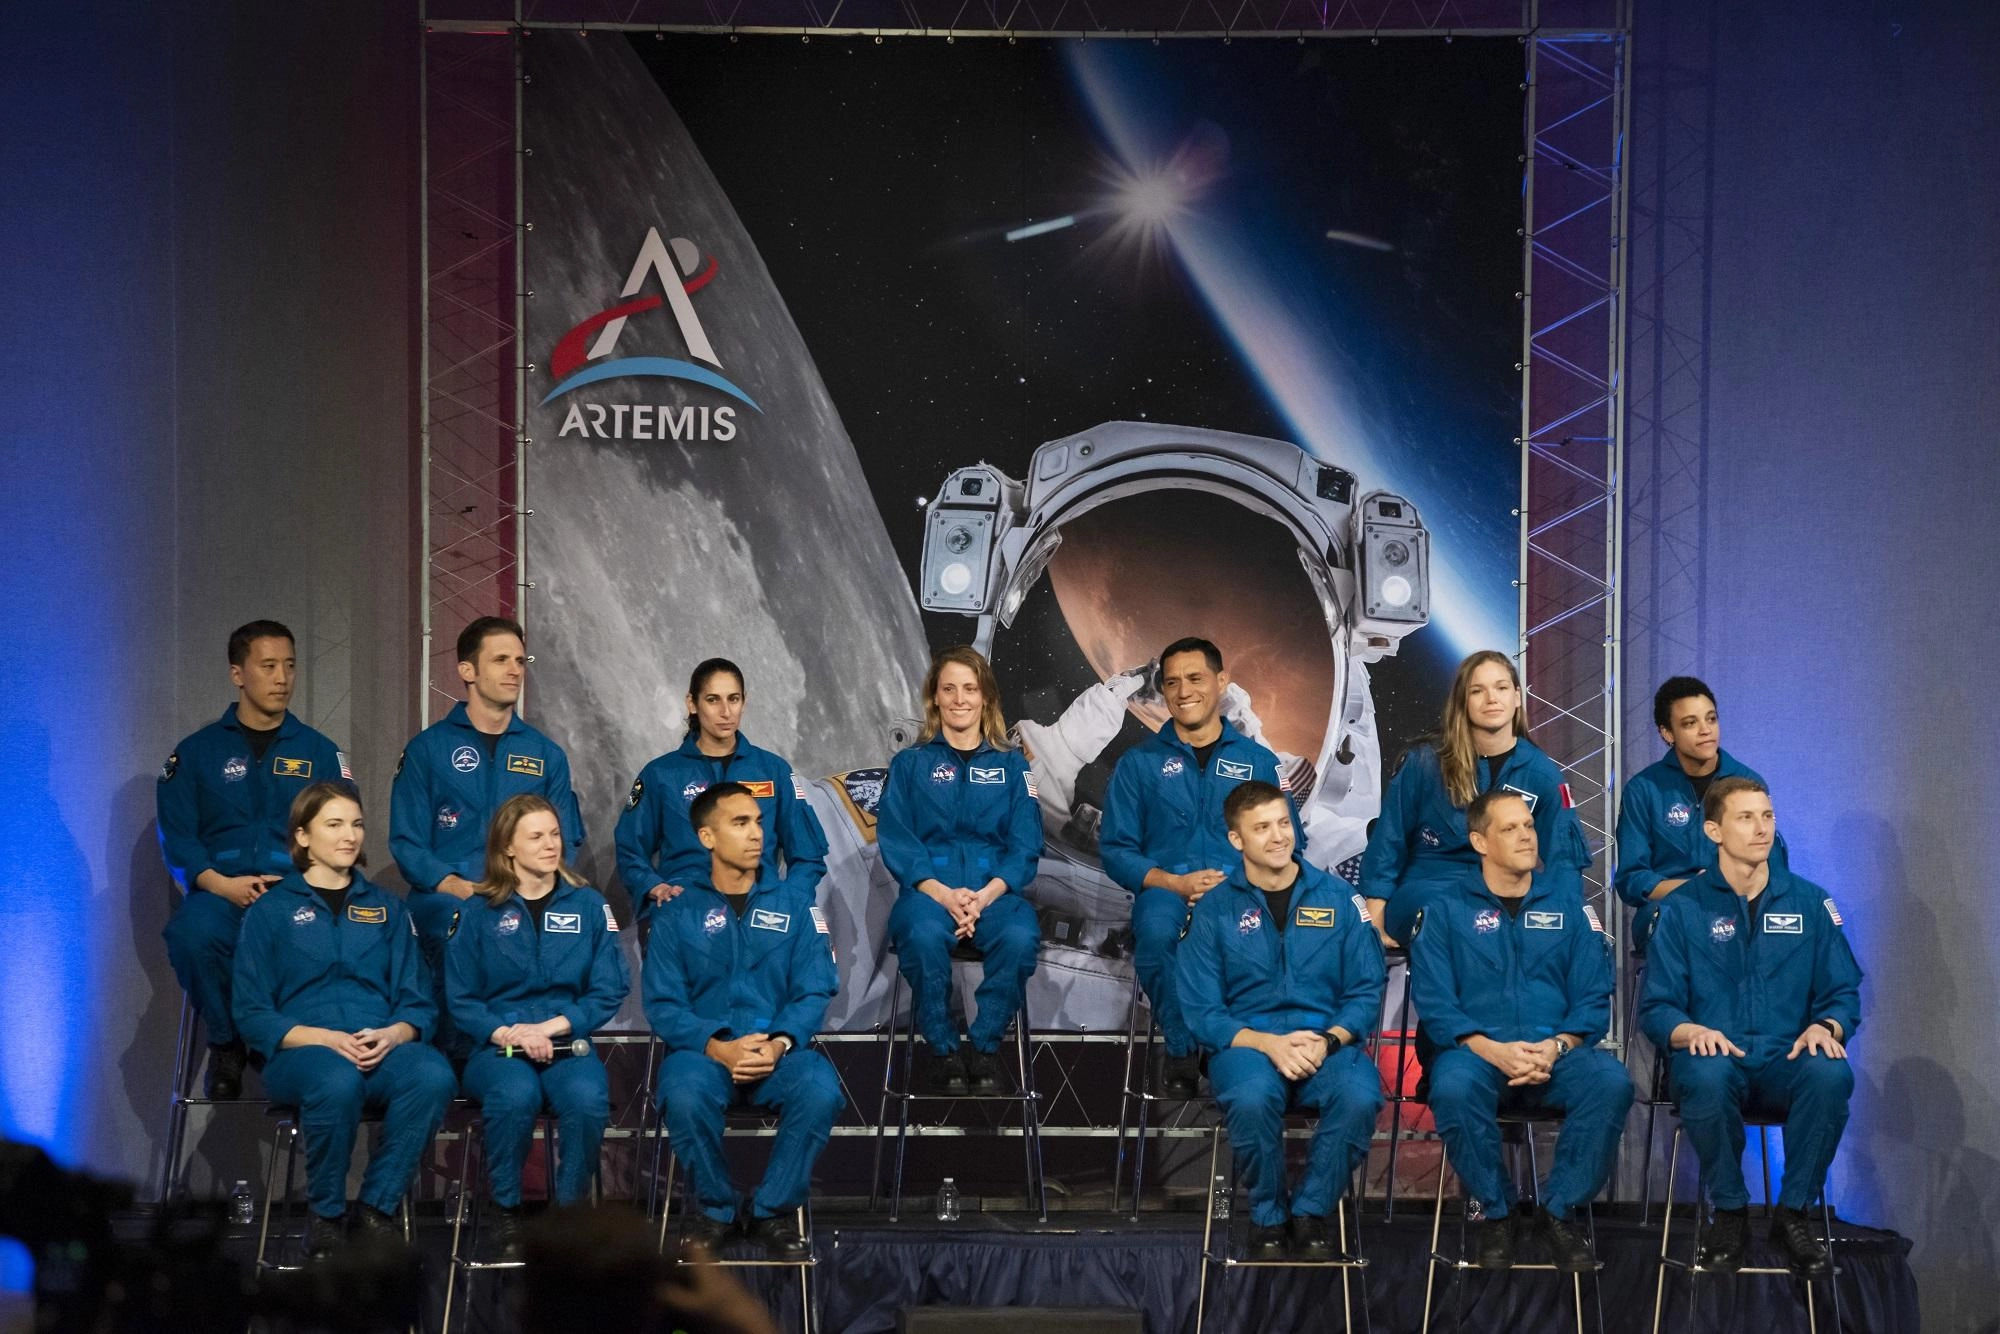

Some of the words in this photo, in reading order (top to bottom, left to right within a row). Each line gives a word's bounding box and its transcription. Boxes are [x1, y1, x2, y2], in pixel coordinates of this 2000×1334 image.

[558, 403, 736, 441] ARTEMIS
[224, 765, 247, 775] NASA
[933, 771, 954, 779] NASA
[1668, 811, 1689, 819] NASA
[1475, 917, 1499, 927] NASA
[1712, 924, 1735, 934] NASA
